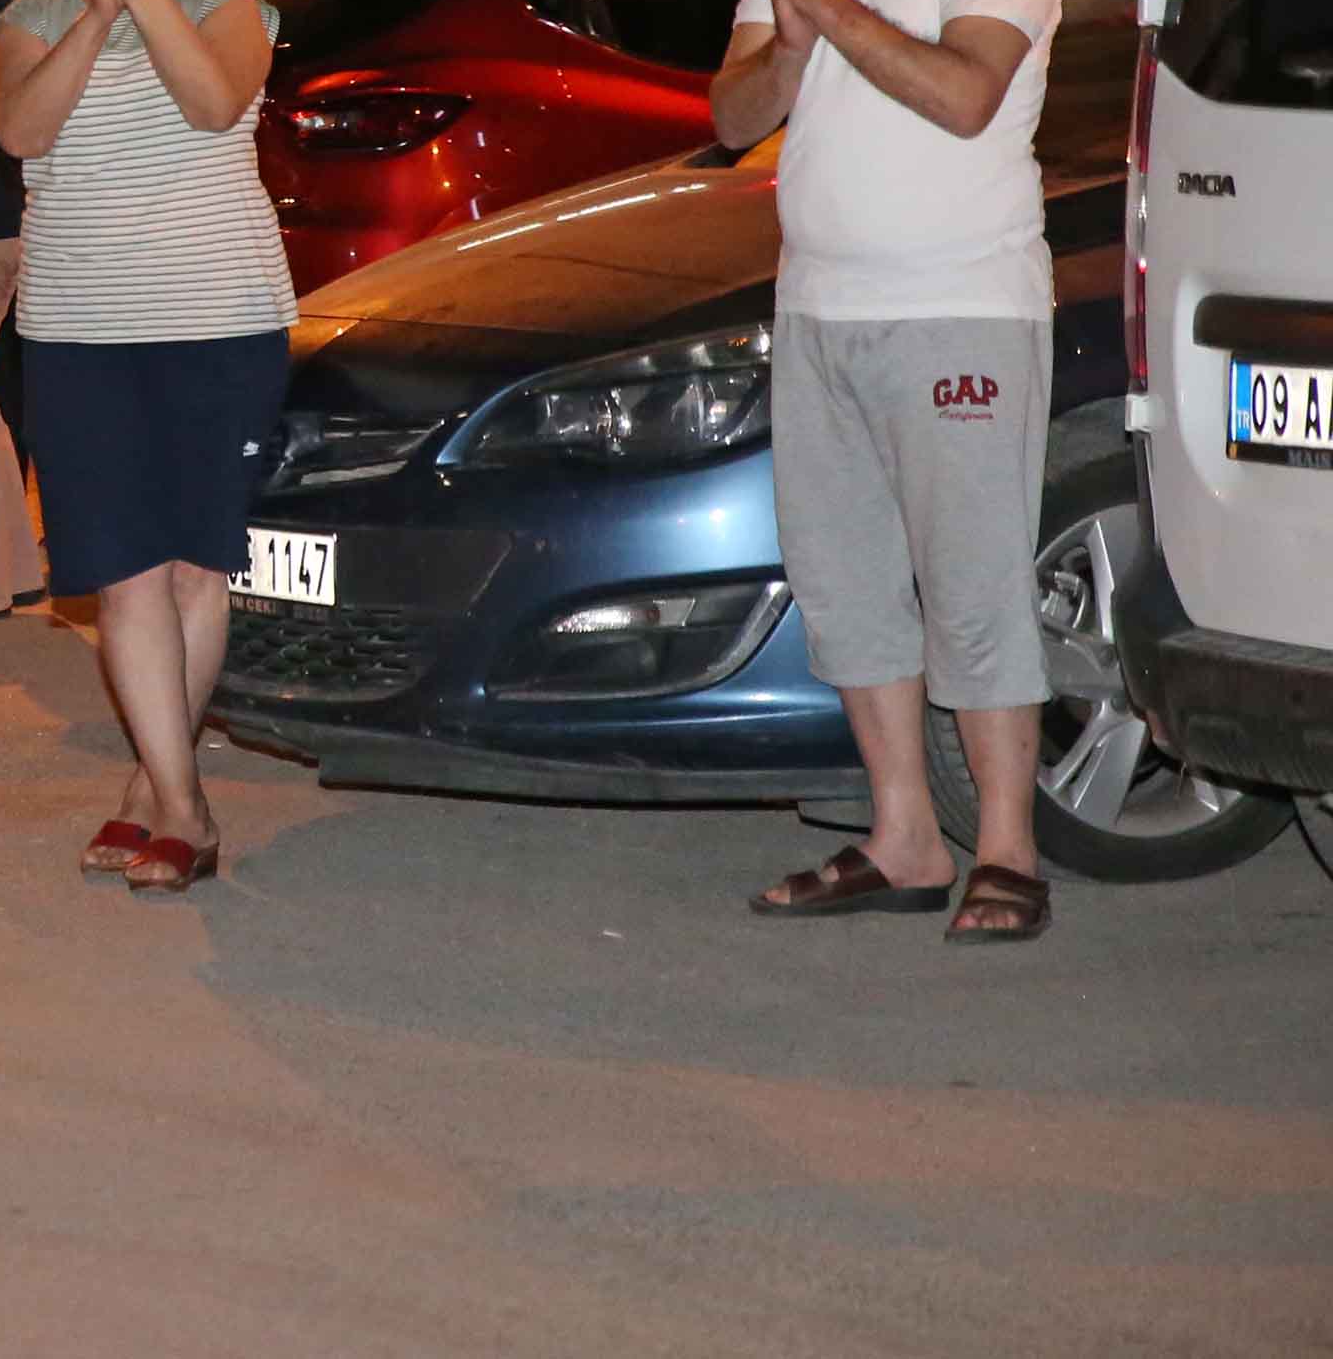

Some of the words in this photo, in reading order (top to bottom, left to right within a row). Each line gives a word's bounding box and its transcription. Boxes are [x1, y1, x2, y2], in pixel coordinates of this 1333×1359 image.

[1178, 173, 1236, 197] DACIA
[933, 375, 999, 408] GAP
[1252, 373, 1288, 436] 09
[1237, 410, 1251, 429] TR
[269, 538, 328, 596] 1147
